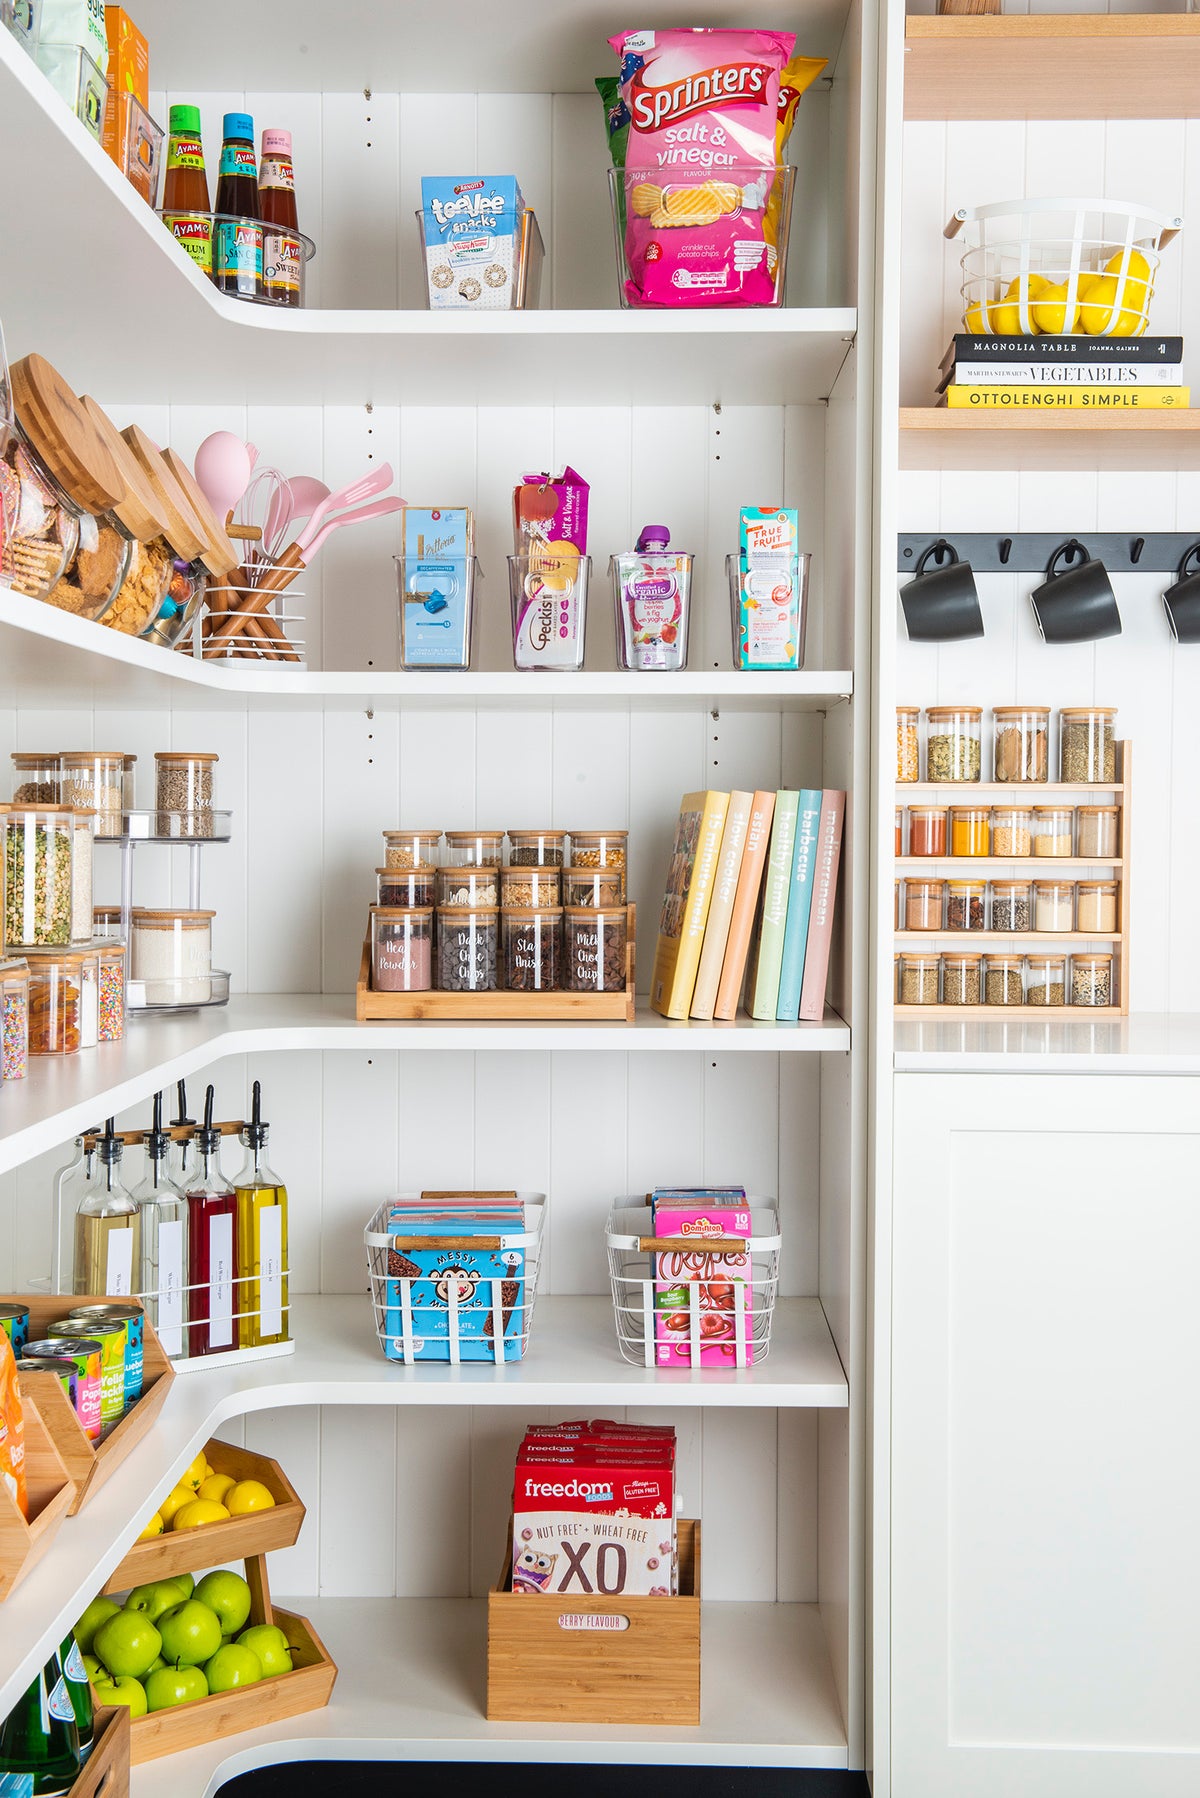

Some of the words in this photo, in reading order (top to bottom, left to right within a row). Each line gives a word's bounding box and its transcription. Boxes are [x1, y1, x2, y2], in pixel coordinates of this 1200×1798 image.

[634, 66, 765, 128] Sprinters
[664, 122, 708, 143] salt
[710, 127, 727, 147] &
[656, 144, 738, 168] vinegar
[683, 170, 712, 178] FLAVOUR
[973, 342, 1036, 352] MAGNOLIA
[1041, 343, 1077, 352] TABLE
[1029, 367, 1138, 382] VEGETABLES
[969, 392, 1073, 405] OTTOLENGHI
[1082, 394, 1139, 406] SIMPLE
[562, 486, 576, 515] Vinegar
[753, 526, 782, 538] TRUE
[753, 535, 782, 548] FRUIT
[635, 586, 666, 597] rganic
[708, 813, 723, 829] 15
[731, 812, 747, 849] slow
[748, 812, 765, 852] asian
[770, 811, 796, 872] healthy
[797, 810, 818, 883] barbecue
[698, 832, 718, 889] minute
[816, 810, 839, 926] mediterranean
[720, 850, 738, 904] cooker
[764, 874, 788, 926] family
[689, 892, 704, 937] meals
[735, 1213, 748, 1224] 10
[436, 1251, 477, 1265] MESSY
[525, 1479, 611, 1497] freedom
[536, 1525, 555, 1539] NUT
[593, 1524, 623, 1539] WHEAT
[626, 1528, 649, 1544] FREE
[557, 1541, 627, 1595] XO
[559, 1614, 584, 1627] BERRY
[586, 1615, 620, 1628] FLAVOUR
